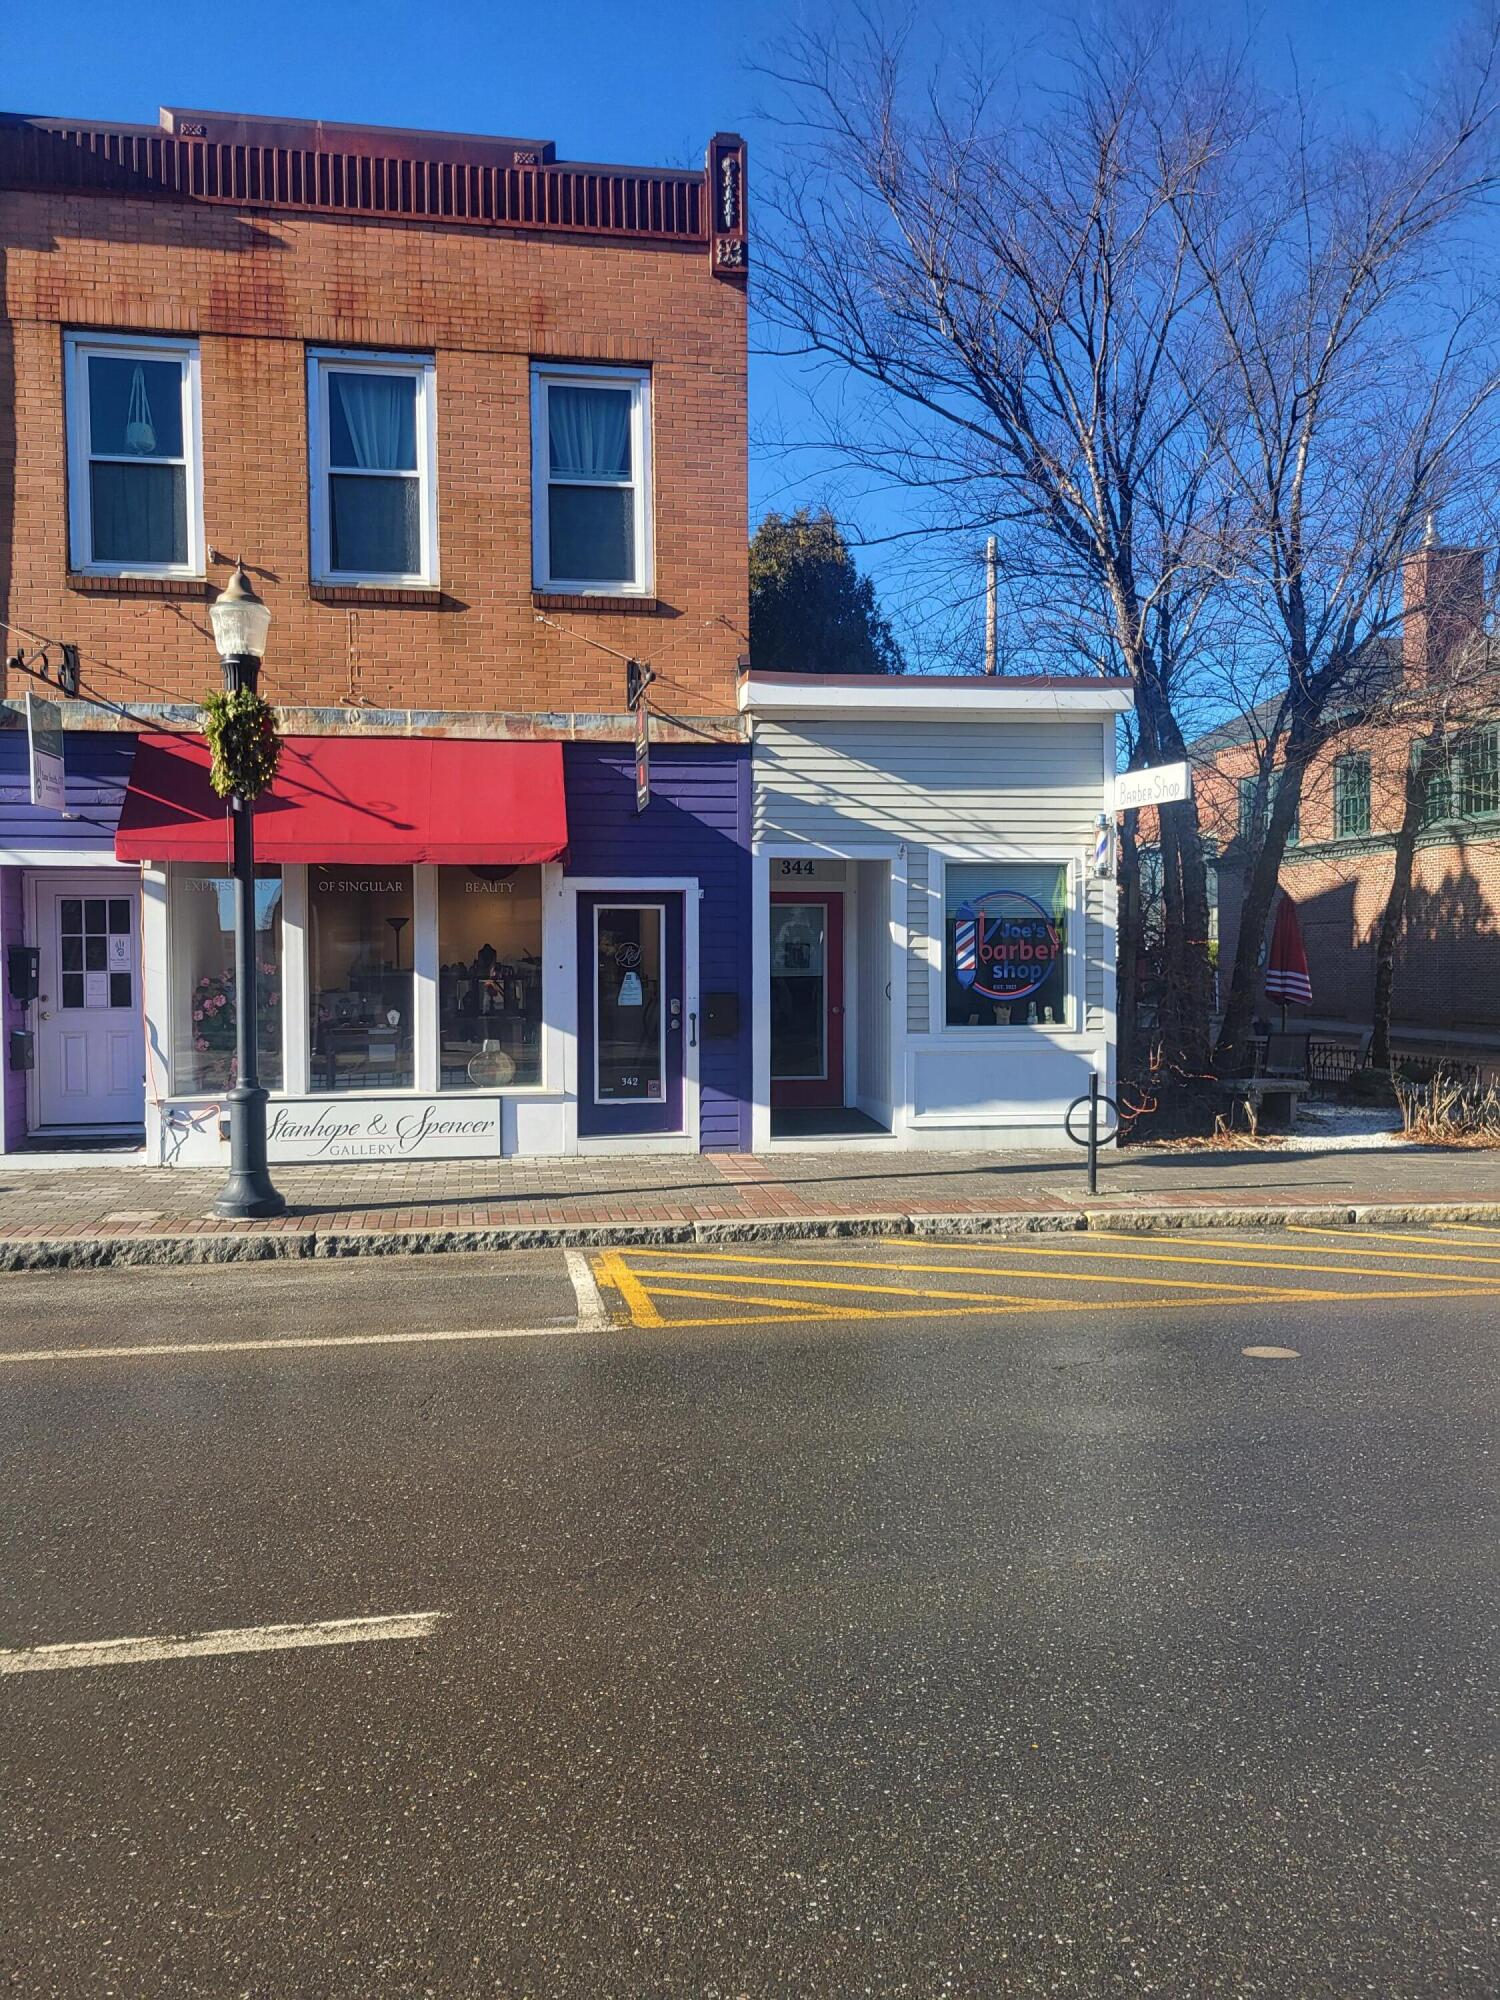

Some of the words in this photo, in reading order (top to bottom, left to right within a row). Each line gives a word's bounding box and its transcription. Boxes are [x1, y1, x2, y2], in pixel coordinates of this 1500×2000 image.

[781, 860, 815, 875] 344
[184, 880, 271, 892] EXPRESNS
[318, 881, 336, 892] OF
[338, 881, 403, 892] SINGULAR
[465, 882, 514, 893] BEAUTY
[1001, 922, 1046, 938] Joe's
[992, 960, 1041, 983] shop
[621, 1077, 639, 1086] 342
[267, 1106, 361, 1157] Stanhope
[367, 1113, 389, 1136] &
[396, 1105, 495, 1155] Spencer
[329, 1144, 396, 1157] GALLERY
